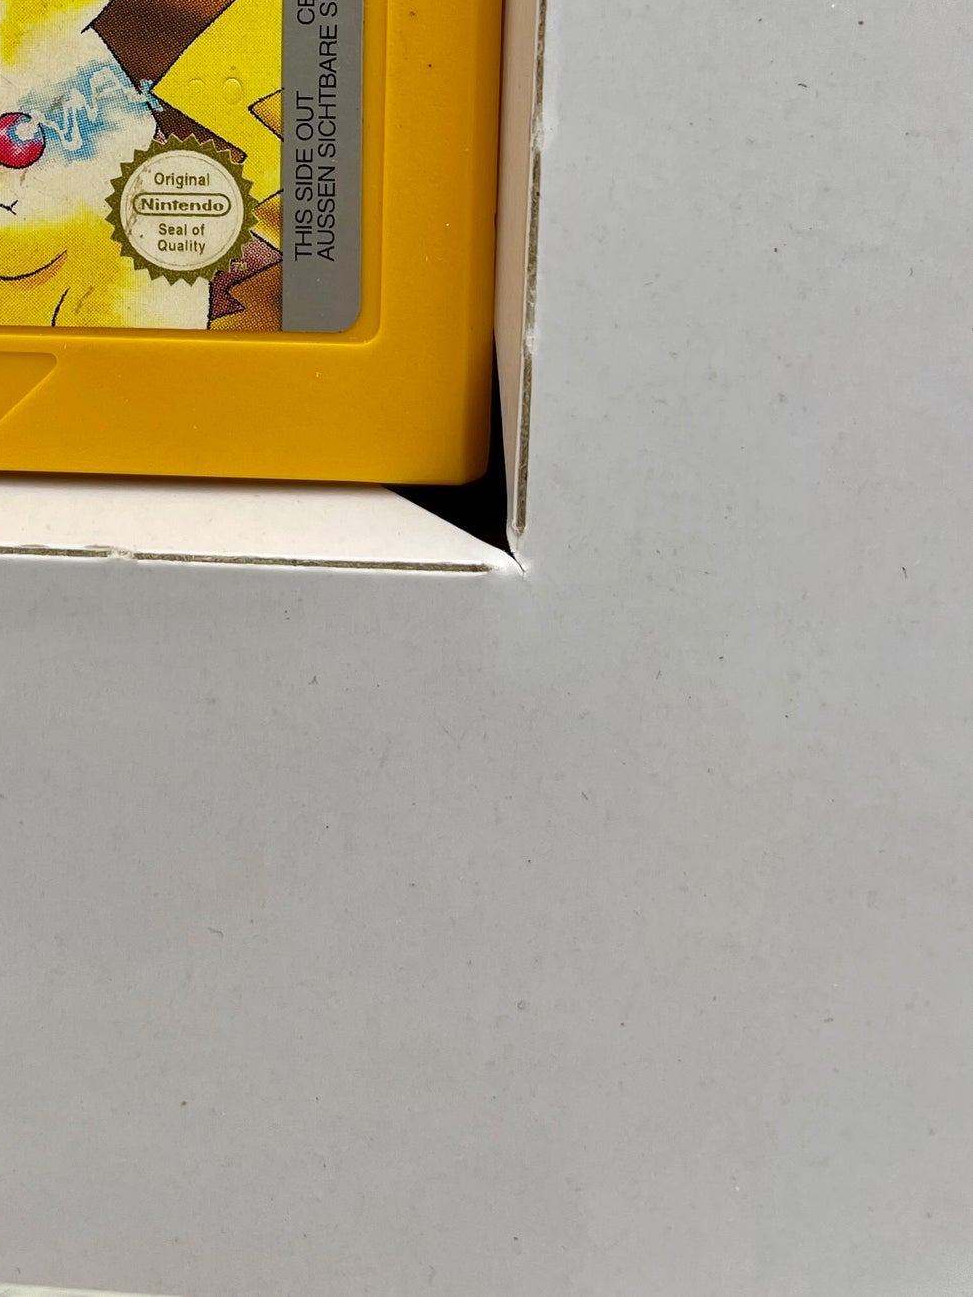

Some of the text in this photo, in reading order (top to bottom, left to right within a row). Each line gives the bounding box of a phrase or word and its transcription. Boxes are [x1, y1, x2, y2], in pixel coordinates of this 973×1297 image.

[318, 24, 338, 158] SICHTBARE
[153, 172, 210, 189] Original
[294, 90, 314, 261] THIS SIDE OUT
[140, 197, 224, 212] Nintendo
[317, 166, 336, 262] AUSSEN
[158, 223, 205, 235] Seal of
[157, 239, 206, 255] Quality
